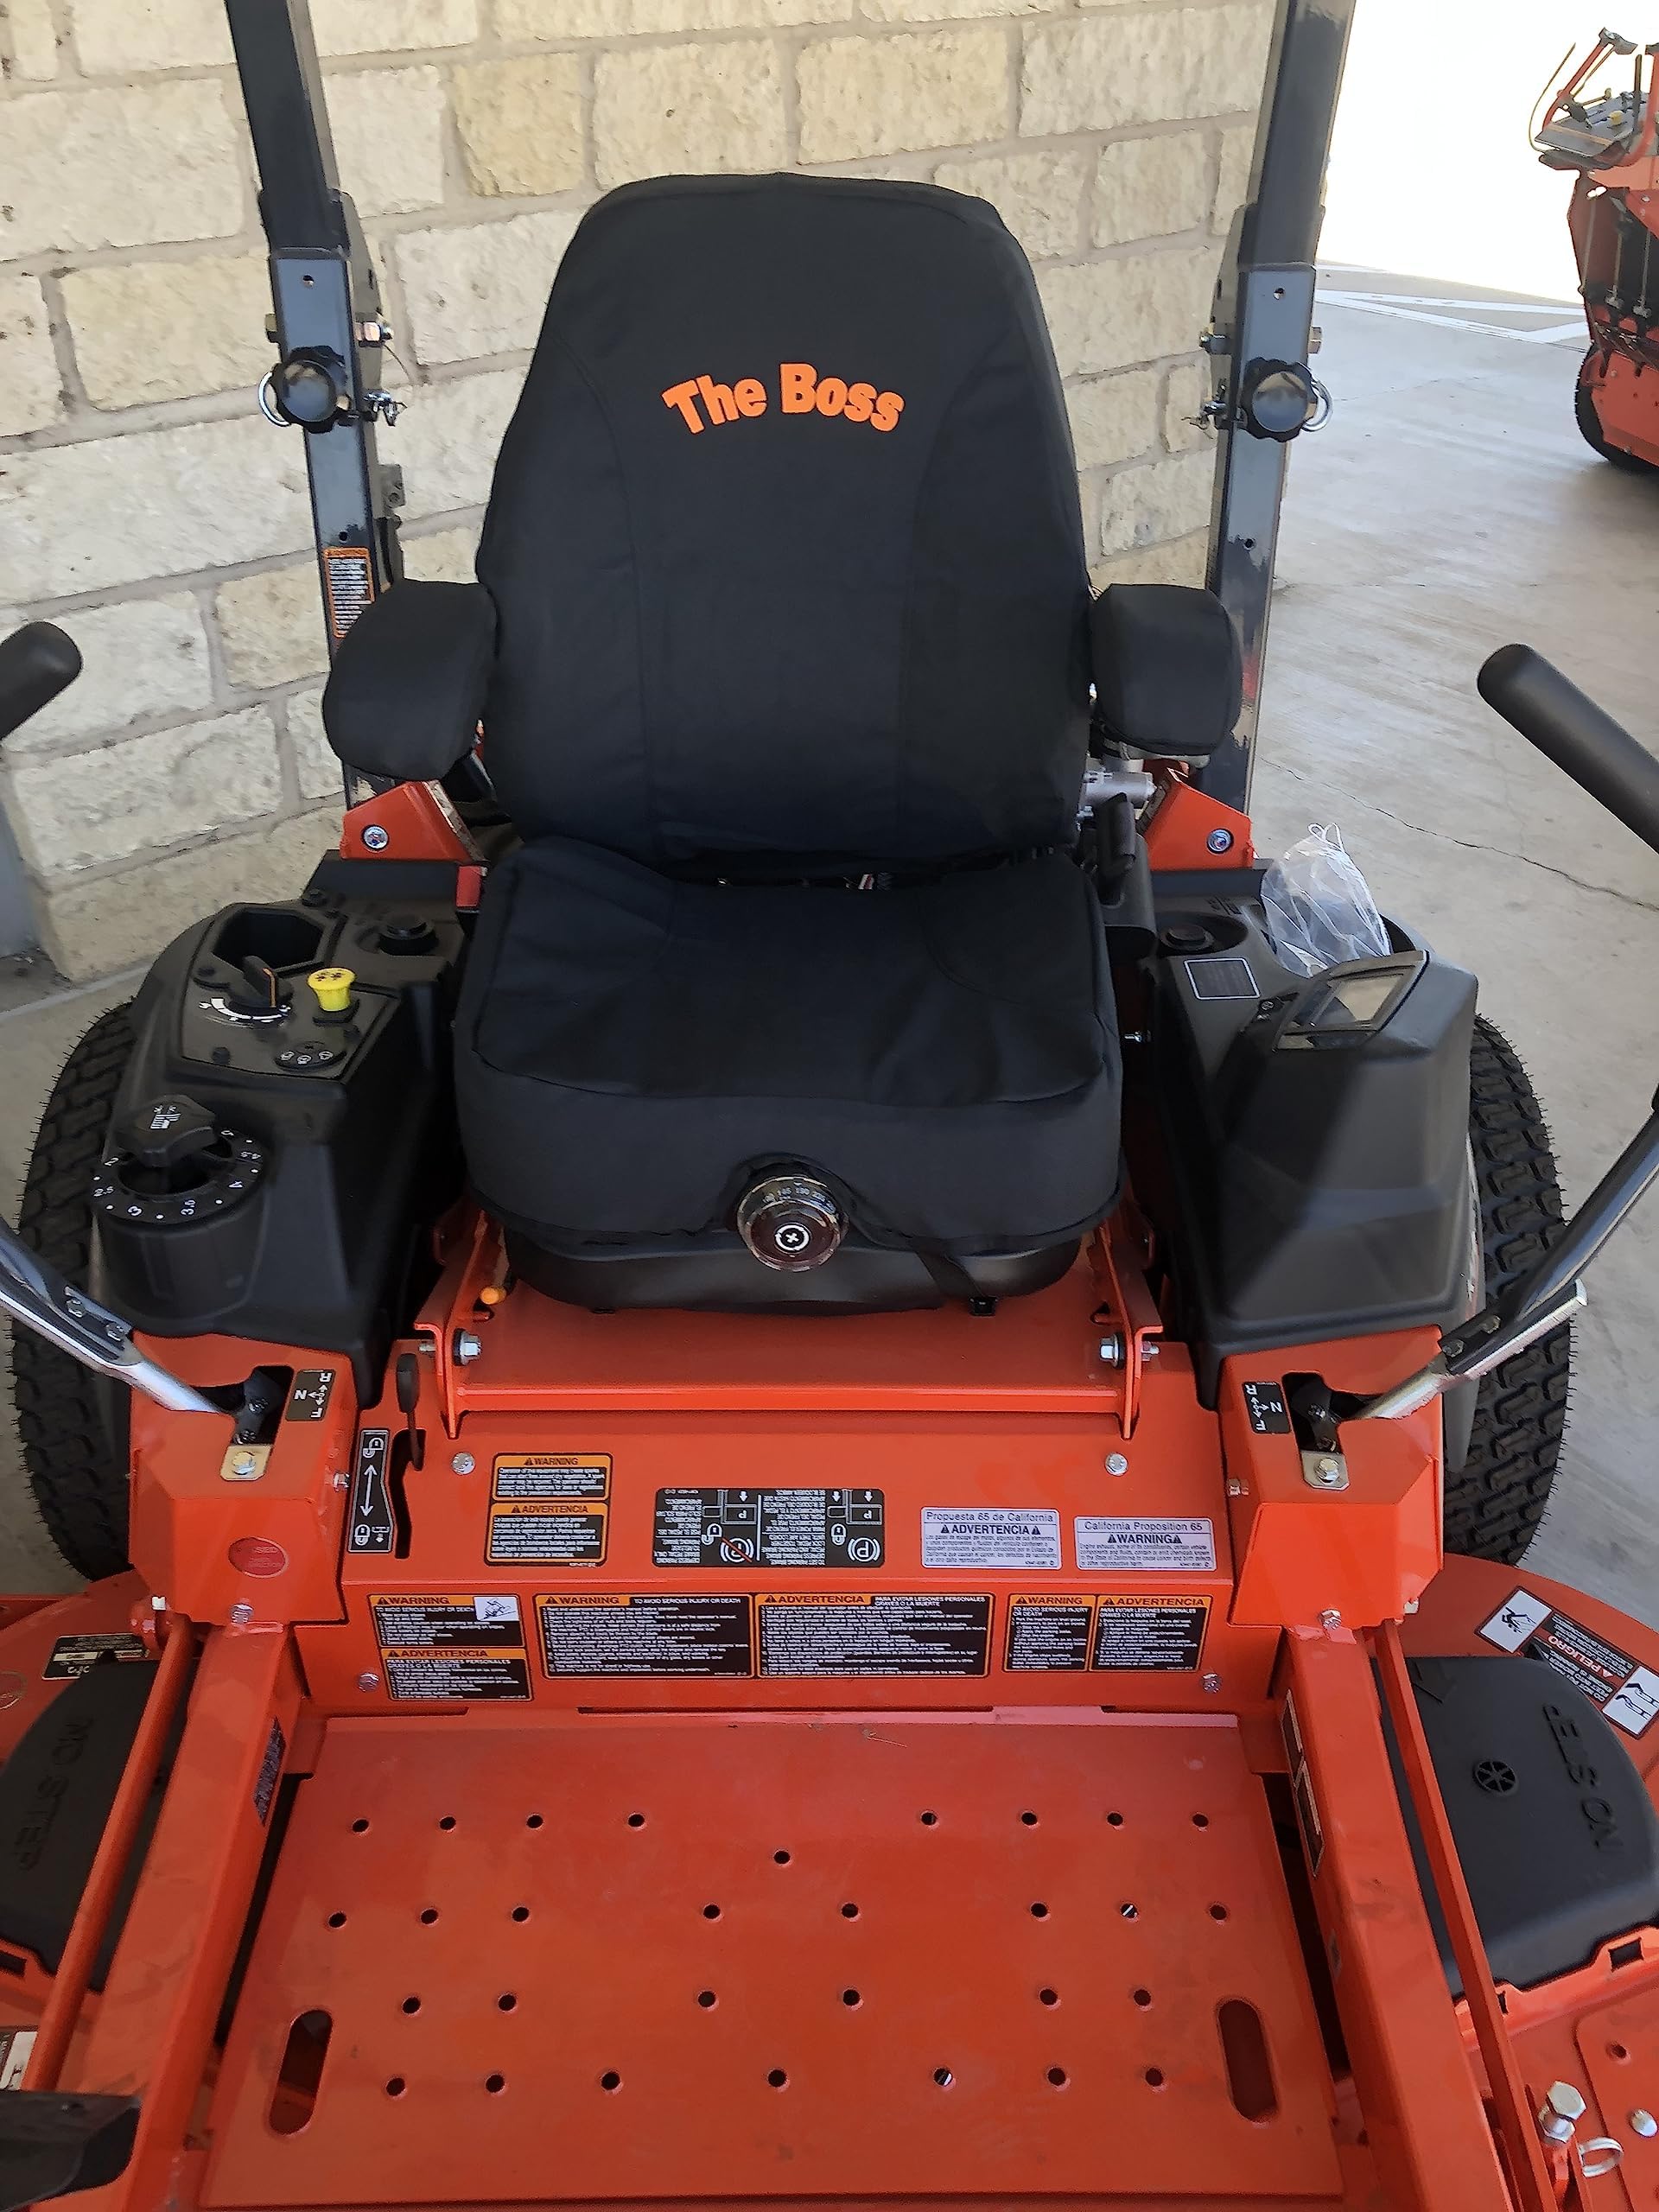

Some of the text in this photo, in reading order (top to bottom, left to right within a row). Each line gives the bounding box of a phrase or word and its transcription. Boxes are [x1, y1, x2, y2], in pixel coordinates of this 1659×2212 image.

[660, 362, 905, 434] The Boss
[105, 1157, 119, 1166] 2
[128, 1205, 143, 1216] 3
[319, 1372, 333, 1382] R
[294, 1389, 308, 1400] N
[1244, 1384, 1258, 1395] R
[310, 1407, 322, 1418] F
[1269, 1401, 1283, 1413] N
[1255, 1419, 1267, 1431] F
[534, 1457, 579, 1465] WARNING
[522, 1505, 588, 1514] ADVERTENCIA
[926, 1511, 1053, 1522] Propuesta 65 de California
[951, 1524, 1030, 1535] ADVERTENCIA
[1084, 1521, 1203, 1532] California Proposition 65
[1116, 1534, 1173, 1544] WARNING
[779, 1595, 865, 1604] ADVERTENCIA
[1116, 1598, 1205, 1606] ADVERTENCIA
[400, 1649, 489, 1658] ADVERTENCIA
[1548, 1635, 1601, 1673] PELIGRO
